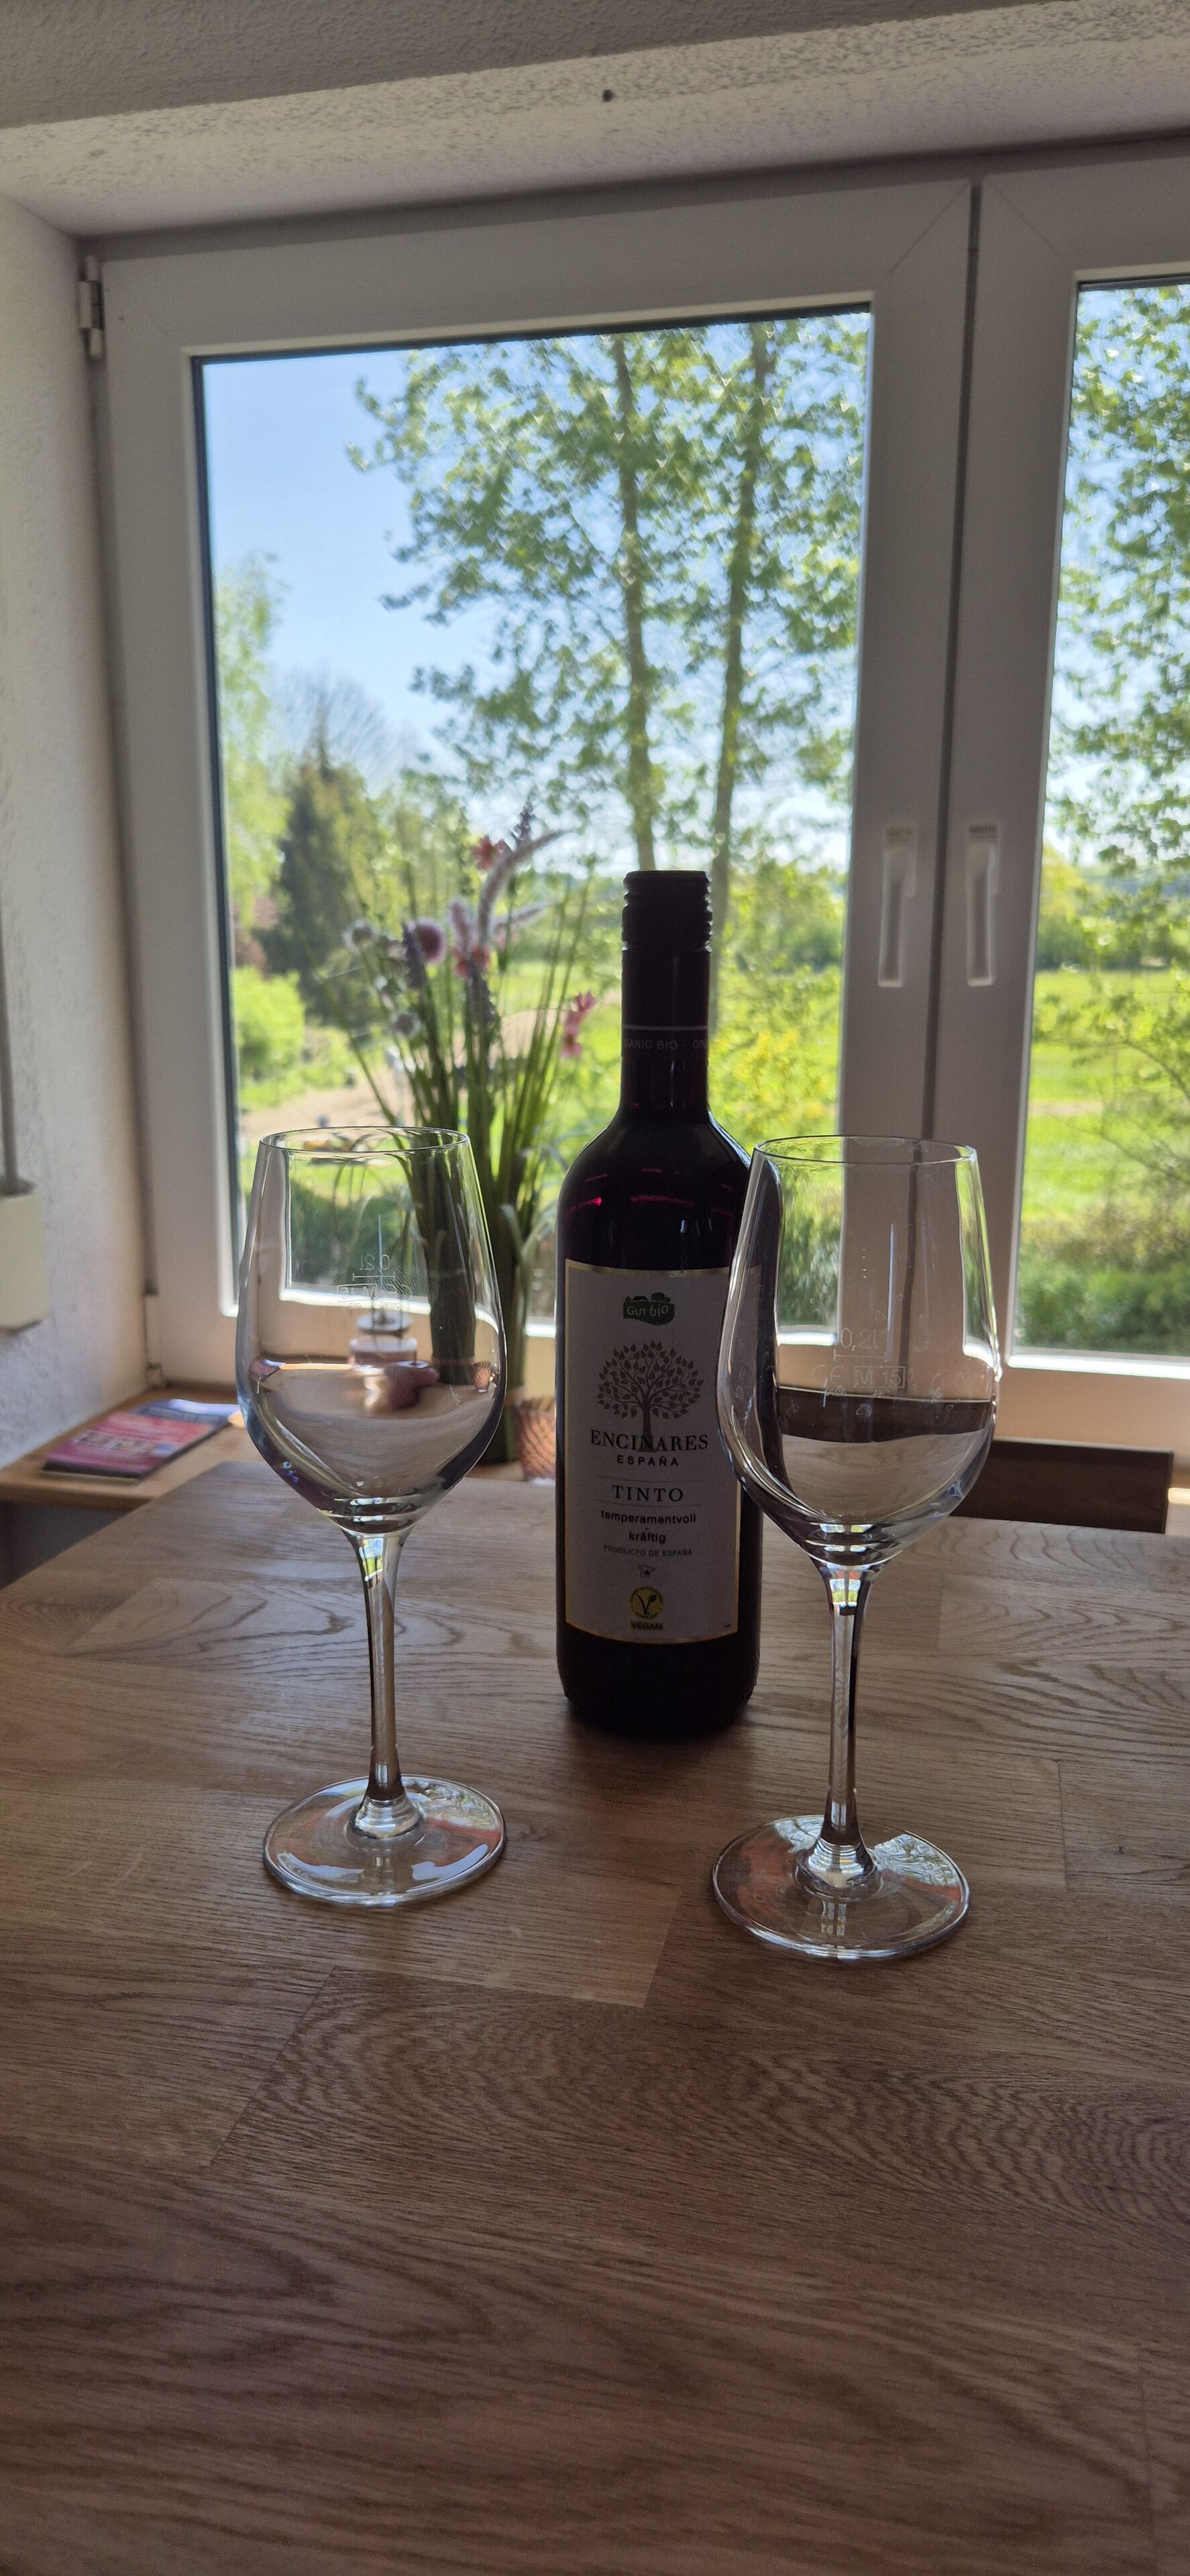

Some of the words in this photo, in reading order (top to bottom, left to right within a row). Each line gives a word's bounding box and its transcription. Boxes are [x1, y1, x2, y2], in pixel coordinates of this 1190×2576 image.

[656, 1040, 678, 1051] BIO
[627, 1305, 647, 1316] GUT
[590, 1429, 708, 1452] ENCINARES
[616, 1454, 679, 1466] ESPAÑA
[612, 1485, 684, 1502] TINTO
[600, 1509, 697, 1524] temperamentvoll
[629, 1530, 666, 1544] kräftig
[603, 1544, 646, 1556] PRODUCTO
[661, 1548, 693, 1556] ESPAÑA
[630, 1621, 663, 1631] VEGAN
